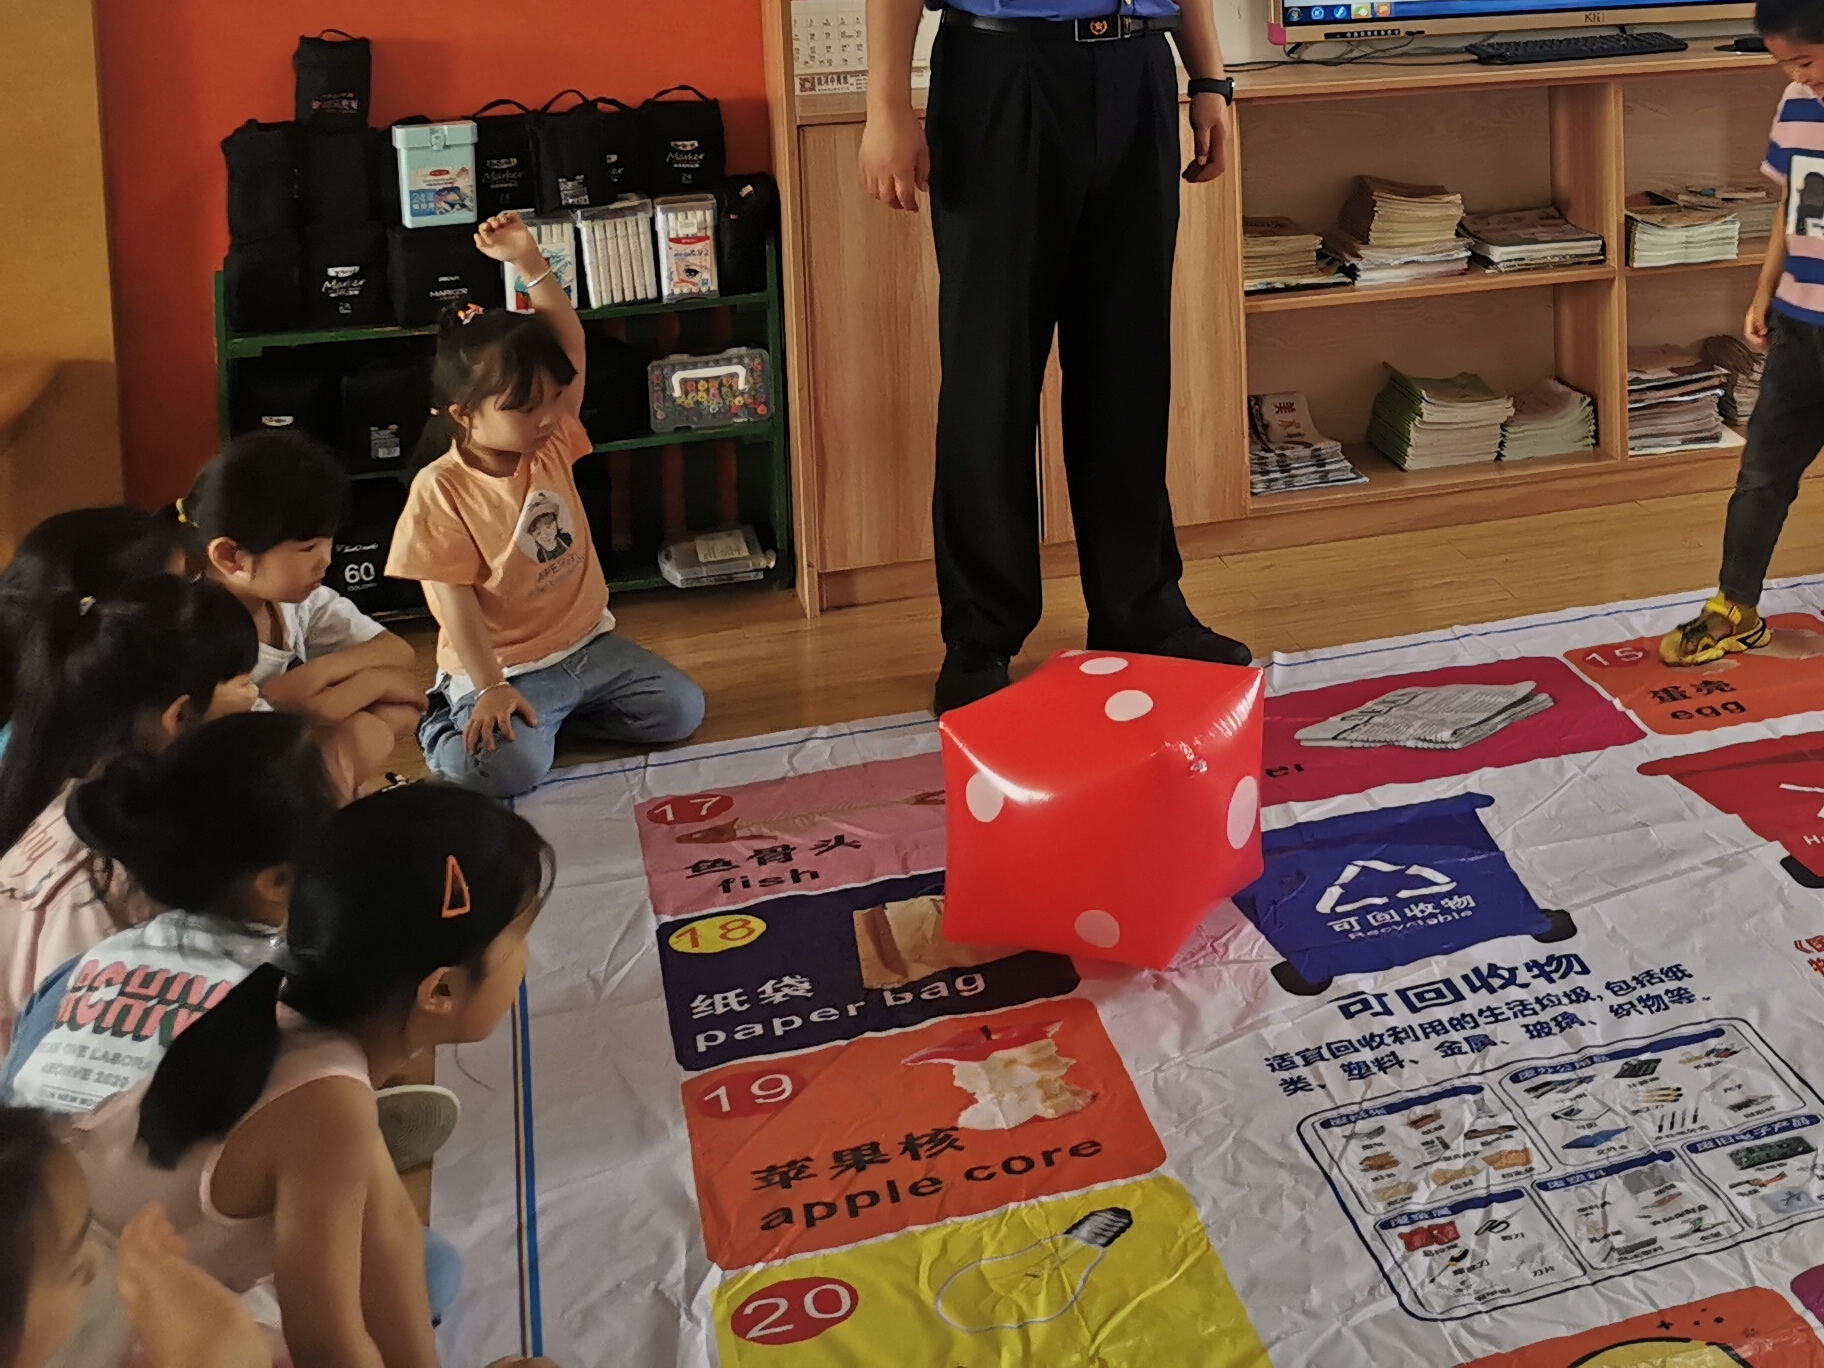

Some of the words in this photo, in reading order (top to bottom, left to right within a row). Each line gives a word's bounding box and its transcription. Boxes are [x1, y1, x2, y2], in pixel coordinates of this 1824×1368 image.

[344, 562, 375, 583] 60
[1586, 647, 1643, 666] 15
[1648, 680, 1737, 704] 蛋壳
[1670, 701, 1747, 720] egg
[655, 796, 718, 822] 17
[683, 835, 861, 879] 鱼骨头
[717, 868, 820, 894] fish
[674, 918, 757, 949] 18
[1327, 894, 1477, 933] 可回收物
[689, 974, 815, 1020] 纸袋
[1328, 953, 1593, 1020] 可回收物
[694, 999, 867, 1052] paper
[885, 970, 987, 1007] bag
[703, 1074, 796, 1115] 19
[750, 1126, 966, 1192] 苹果核
[758, 1174, 943, 1231] apple
[965, 1136, 1104, 1184] core
[740, 1284, 853, 1339] 20
